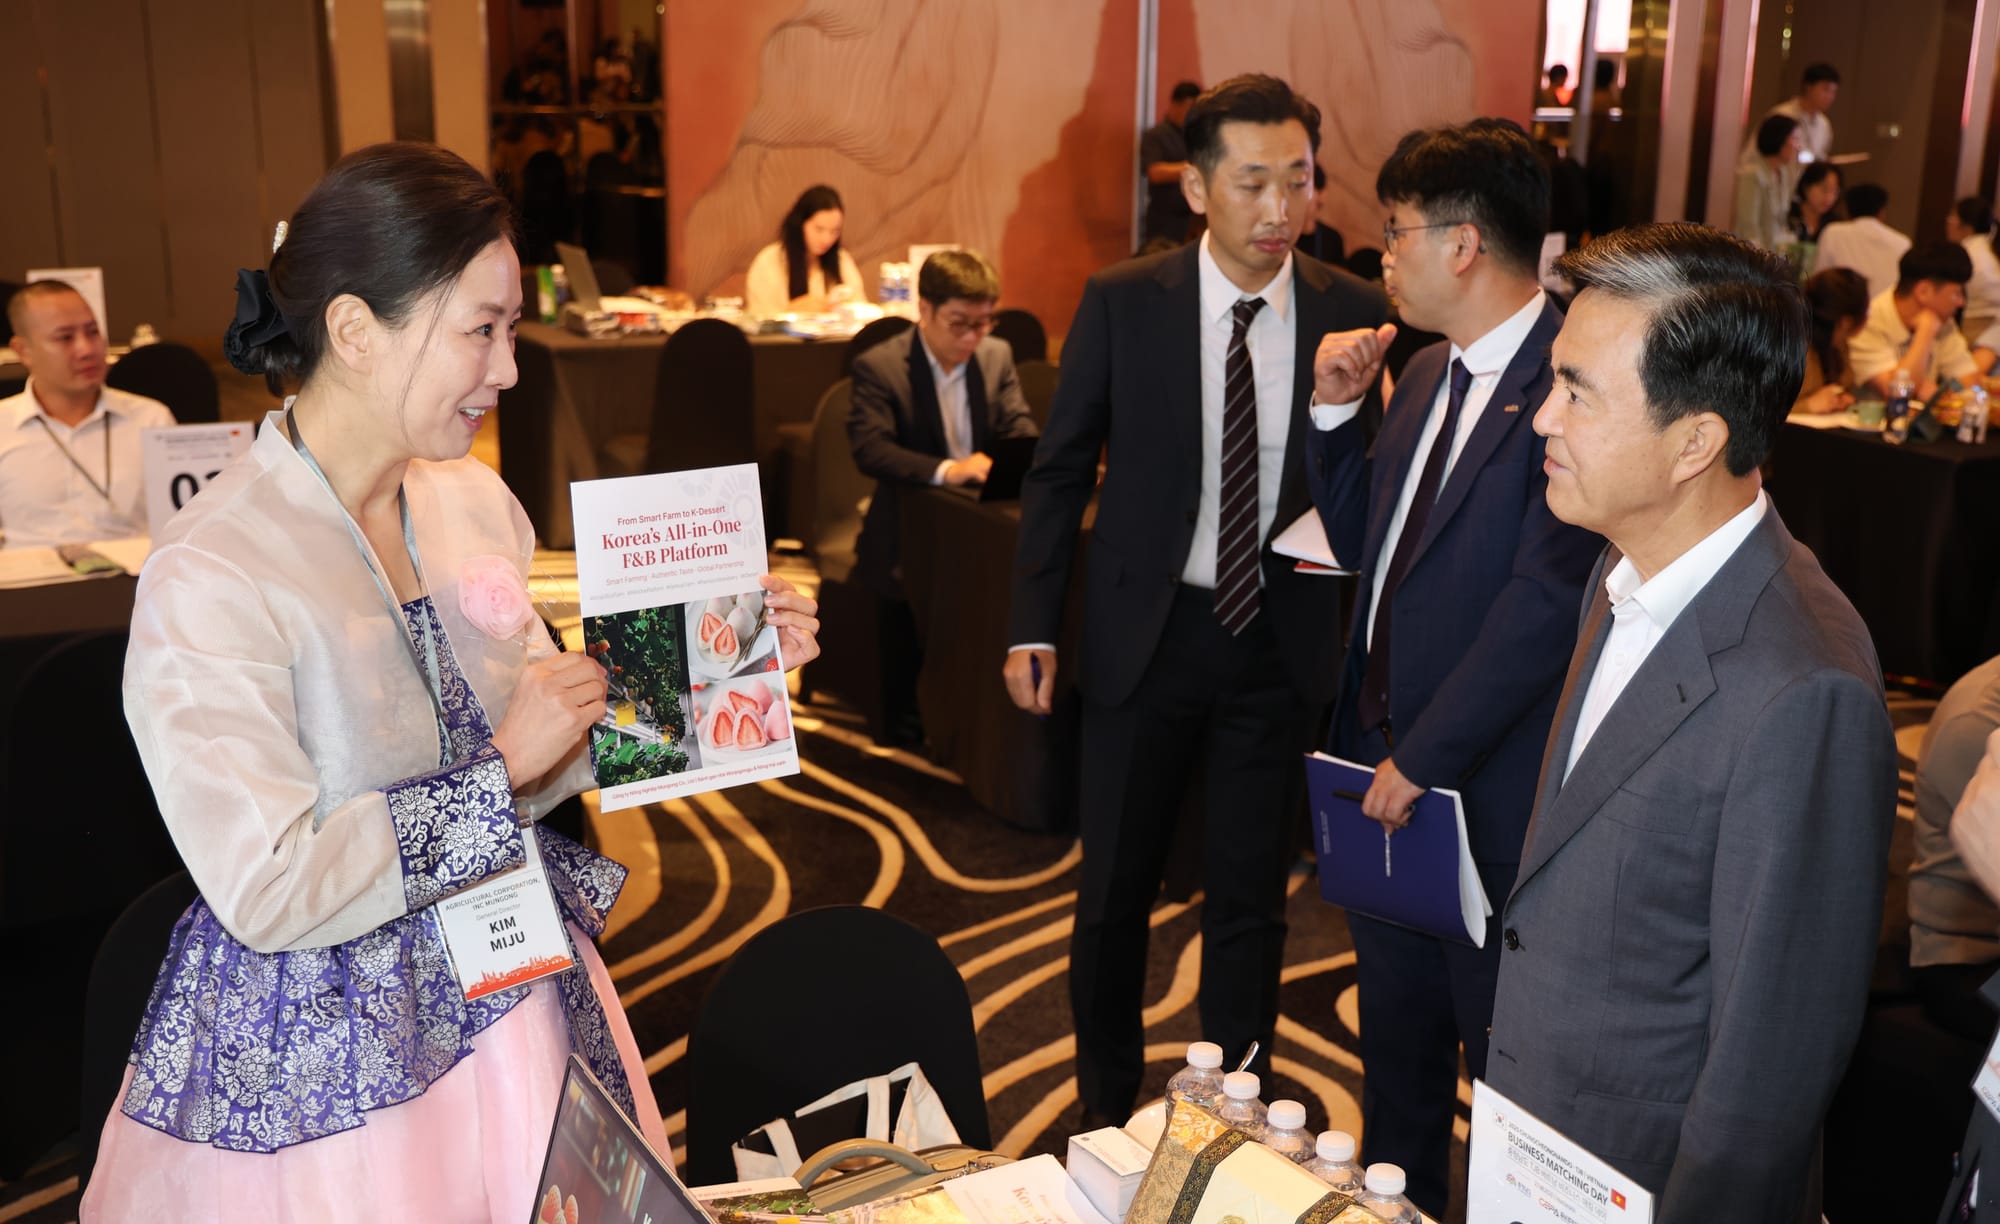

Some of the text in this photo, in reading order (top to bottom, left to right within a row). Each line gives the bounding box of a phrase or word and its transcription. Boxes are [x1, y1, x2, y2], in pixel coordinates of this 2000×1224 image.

[170, 472, 222, 511] 0
[617, 505, 726, 526] From Smart Farm to K-Dessert
[602, 519, 742, 549] Korea's All-in-One
[622, 542, 728, 568] F&B Platform
[606, 576, 623, 586] Smart
[445, 877, 541, 911] AGRICULTURAL CORPORATION,
[472, 891, 518, 911] INC MUNGONG
[475, 903, 521, 921] General Director
[489, 916, 517, 934] KIM
[490, 931, 526, 952] MIJU
[1508, 1131, 1545, 1163] BUSINESS
[1546, 1157, 1590, 1194] MATCHING
[1590, 1187, 1608, 1206] DAY
